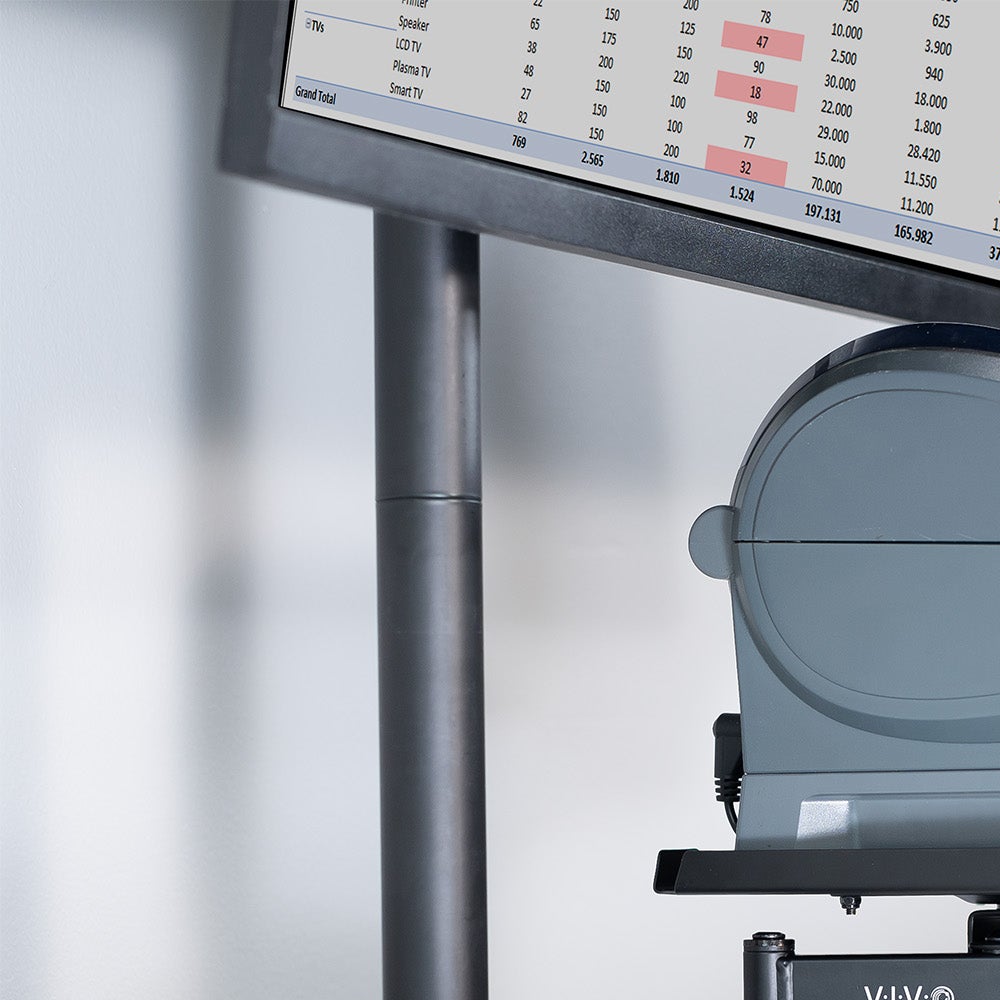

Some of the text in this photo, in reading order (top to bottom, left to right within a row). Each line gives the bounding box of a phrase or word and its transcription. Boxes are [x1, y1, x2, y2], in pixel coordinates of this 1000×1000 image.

[530, 17, 540, 31] 65
[601, 31, 617, 46] 175
[676, 45, 693, 60] 150
[753, 60, 765, 74] 90
[824, 73, 857, 92] 30.000
[914, 91, 948, 110] 18.000
[604, 7, 621, 22] 150
[680, 21, 696, 36] 125
[756, 35, 769, 49] 47
[830, 48, 858, 66] 2.500
[925, 66, 944, 82] 940
[682, 0, 700, 11] 200
[760, 9, 772, 24] 78
[831, 22, 863, 41] 10.000
[924, 38, 953, 57] 3.900
[842, 0, 860, 14] 750
[932, 13, 951, 29] 625
[312, 20, 325, 33] TVs
[395, 37, 411, 51] LCD
[411, 40, 422, 53] TV
[523, 64, 535, 78] 48
[595, 79, 611, 94] 150
[670, 94, 687, 110] 100
[746, 110, 759, 125] 98
[817, 125, 850, 144] 29.000
[907, 143, 941, 163] 28.420
[392, 59, 420, 77] Plasma
[420, 65, 432, 78] TV
[520, 87, 532, 100] 27
[592, 103, 608, 118] 150
[666, 119, 683, 134] 100
[743, 135, 756, 149] 77
[814, 151, 846, 170] 15.000
[903, 170, 938, 190] 11.550
[398, 15, 430, 32] Speaker
[527, 40, 538, 54] 38
[598, 54, 614, 70] 200
[673, 70, 690, 85] 220
[750, 85, 762, 100] 18
[820, 99, 853, 118] 22.000
[914, 118, 942, 136] 1.800
[295, 85, 318, 101] Grand
[318, 90, 337, 105] Total
[511, 134, 527, 149] 769
[581, 150, 605, 168] 2.565
[655, 168, 680, 185] 1.810
[729, 185, 755, 203] 1.524
[804, 202, 841, 224] 197.131
[894, 223, 934, 246] 165.982
[389, 81, 412, 98] Smart
[412, 86, 424, 100] TV
[517, 110, 528, 125] 82
[588, 126, 605, 142] 150
[663, 143, 680, 159] 200
[740, 160, 752, 175] 32
[811, 176, 843, 196] 70.000
[900, 196, 934, 217] 11.200
